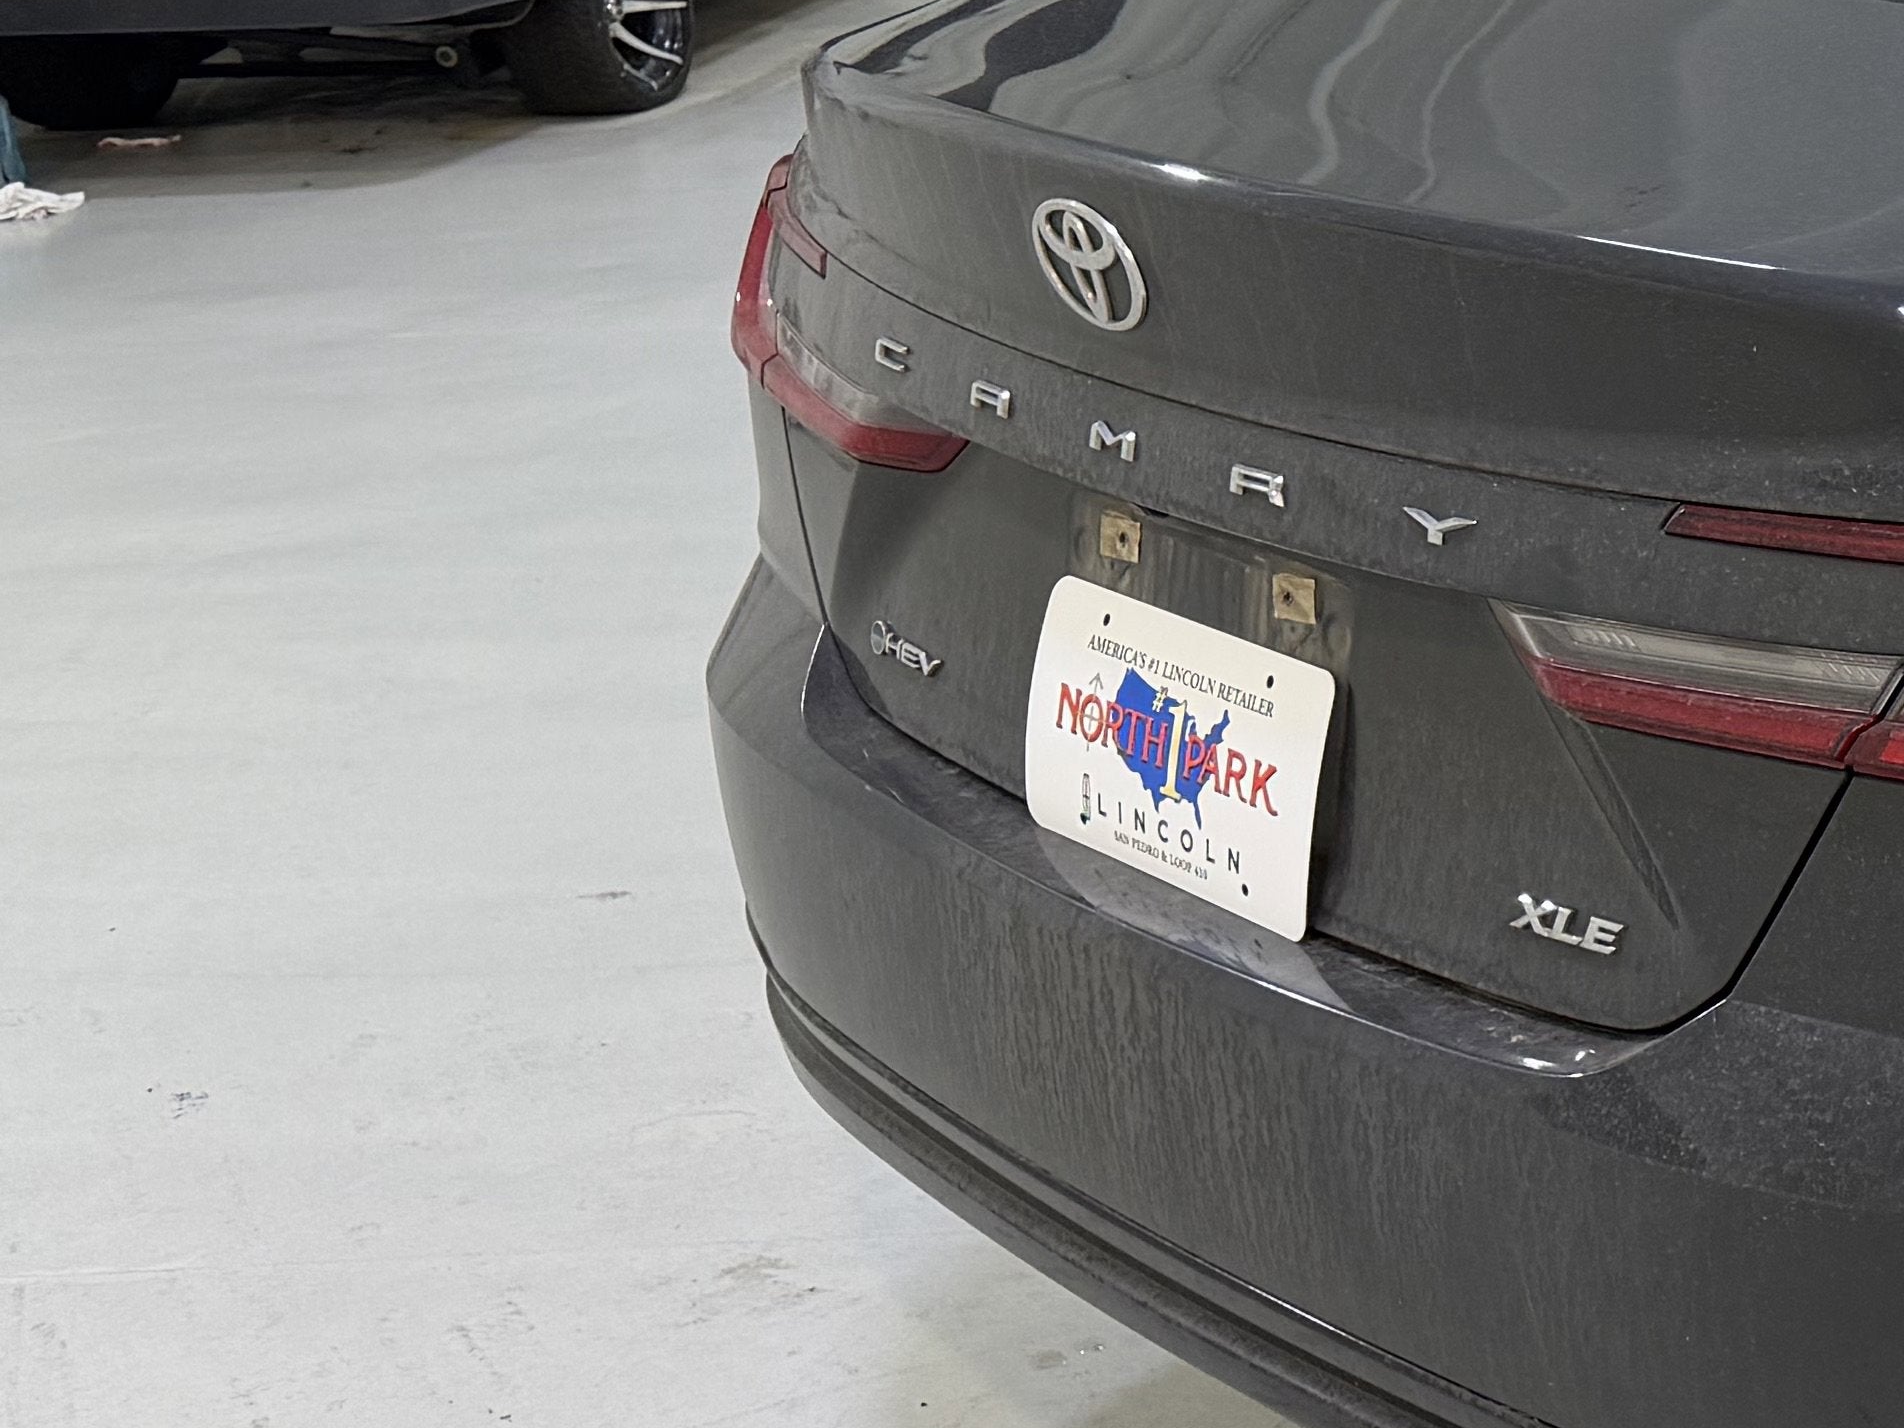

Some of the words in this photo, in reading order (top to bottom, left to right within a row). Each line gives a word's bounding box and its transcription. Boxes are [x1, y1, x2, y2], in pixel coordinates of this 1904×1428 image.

[875, 336, 1478, 546] CAMRY
[885, 632, 942, 676] HEV
[1087, 634, 1147, 670] AMERICA'S
[1147, 656, 1160, 675] #1
[1161, 661, 1217, 696] LINCOLN
[1217, 682, 1275, 718] RETAILER
[1056, 682, 1168, 768] NORTH
[1182, 734, 1279, 817] PARK
[1097, 792, 1241, 874] LINCOLN
[1131, 837, 1160, 859] PEDRO
[1169, 853, 1193, 873] LOOP
[1508, 893, 1625, 955] XLE
